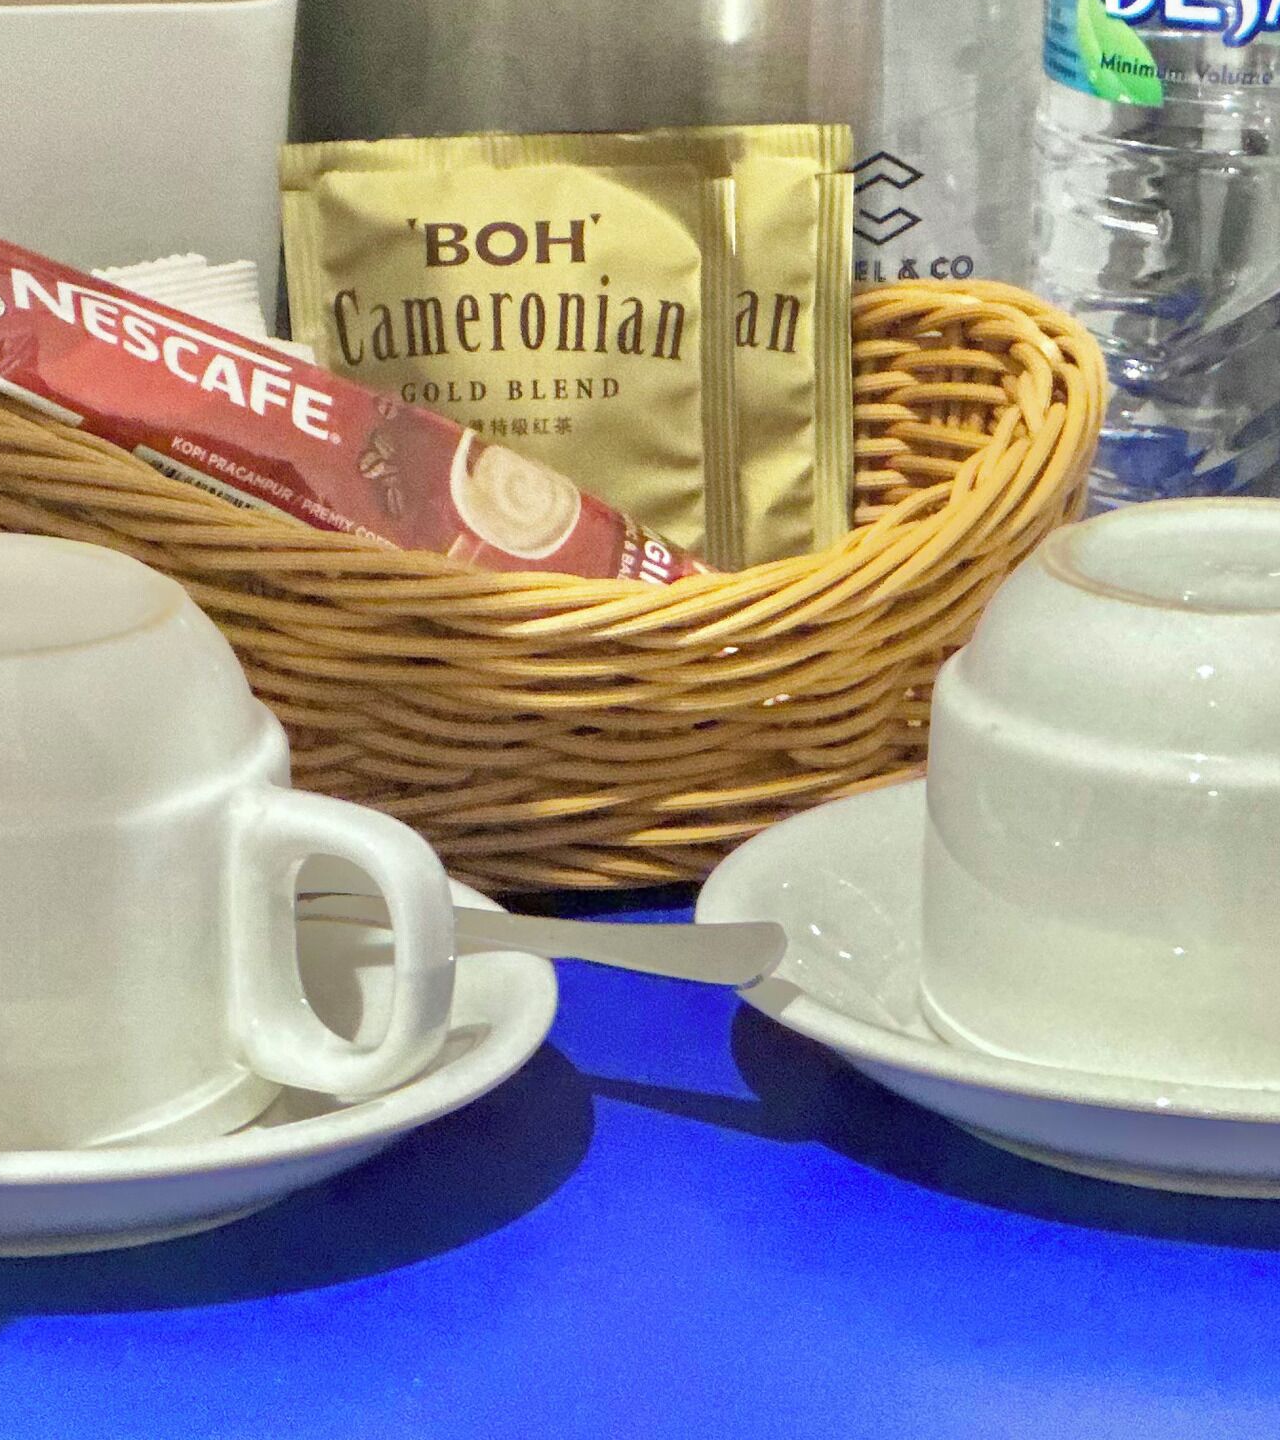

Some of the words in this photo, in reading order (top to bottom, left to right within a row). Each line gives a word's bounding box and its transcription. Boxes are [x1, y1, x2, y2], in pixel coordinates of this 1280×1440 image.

[1100, 53, 1185, 83] Minimum
[1197, 63, 1274, 85] Volume
[898, 257, 919, 281] &
[931, 254, 974, 281] CO
[333, 275, 687, 368] Cameronian
[401, 378, 488, 403] GOLD
[509, 375, 622, 401] BLEND
[171, 435, 206, 462] KOPI
[207, 452, 296, 502] PRACAMPUR
[301, 498, 355, 533] PREMIX
